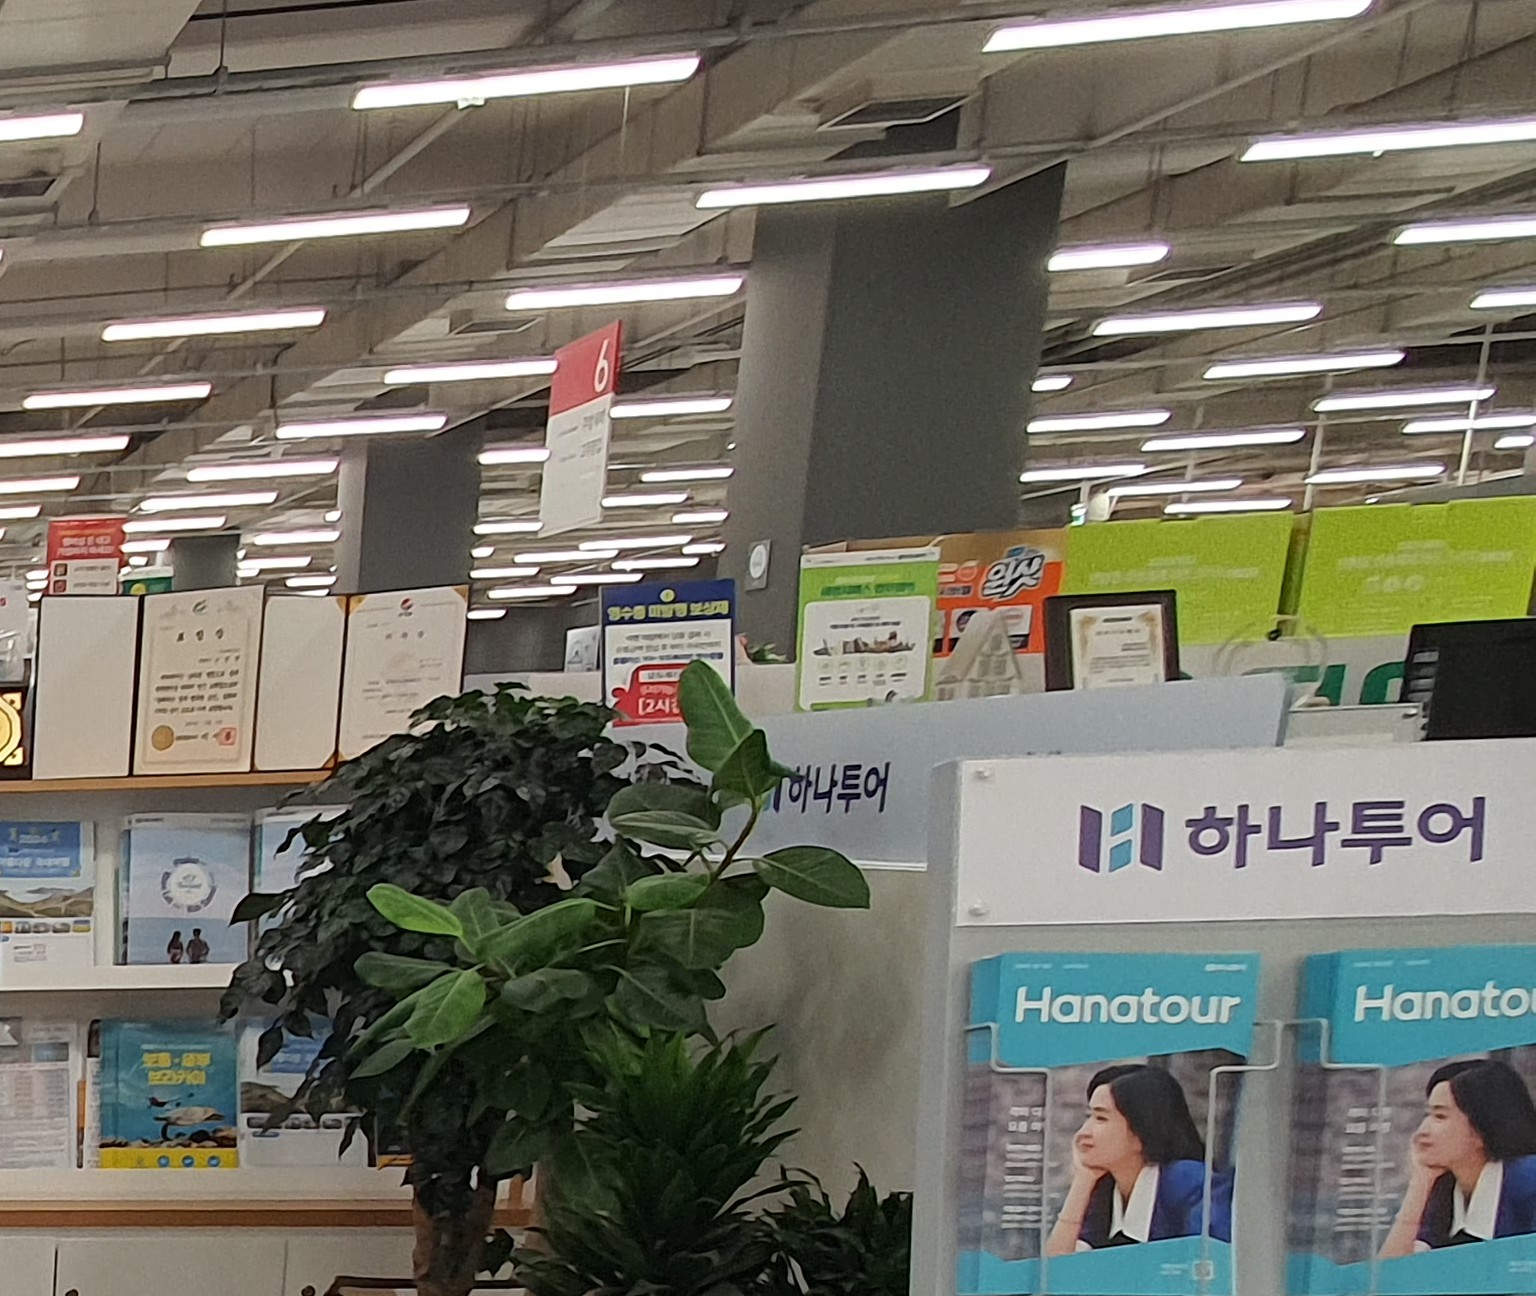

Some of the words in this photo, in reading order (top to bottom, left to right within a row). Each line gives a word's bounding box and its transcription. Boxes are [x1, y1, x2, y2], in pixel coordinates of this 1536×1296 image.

[594, 338, 609, 392] 6
[787, 762, 891, 814] 하나투어
[1184, 796, 1487, 870] 하나투어
[1015, 985, 1242, 1025] Hanatour
[1354, 980, 1536, 1022] Hanato
